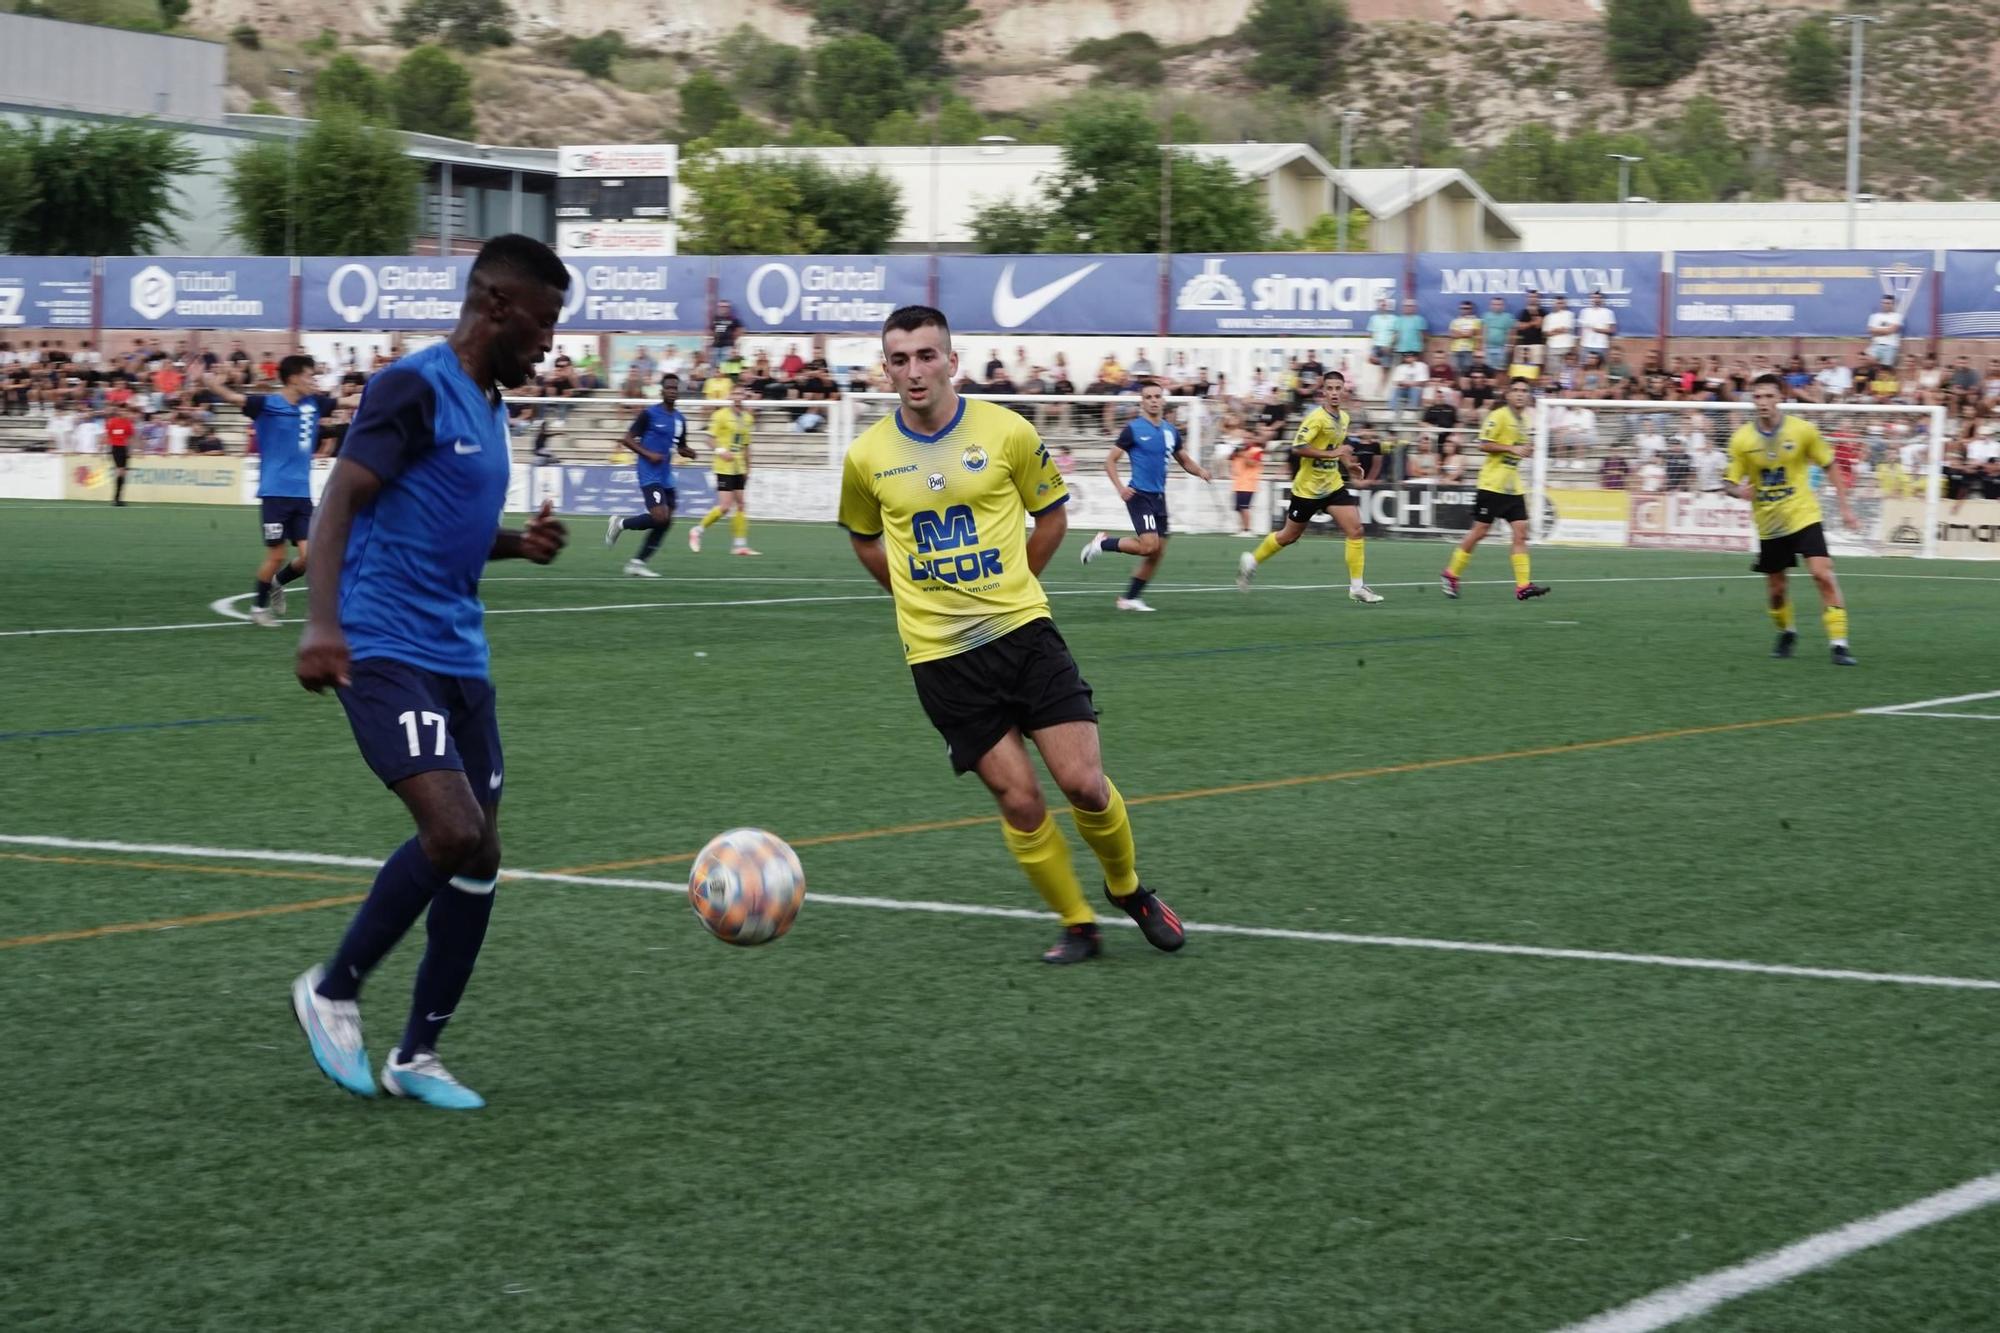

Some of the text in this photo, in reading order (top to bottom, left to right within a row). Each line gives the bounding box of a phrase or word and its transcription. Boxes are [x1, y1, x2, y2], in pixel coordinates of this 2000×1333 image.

[378, 265, 457, 290] Global
[586, 265, 668, 290] Global
[801, 265, 885, 290] Global
[1440, 267, 1632, 293] MYRIAM VAL
[1252, 274, 1396, 312] simar
[883, 464, 918, 478] PATRICK
[653, 491, 661, 504] 9
[1143, 514, 1156, 530] 10
[399, 711, 446, 757] 17
